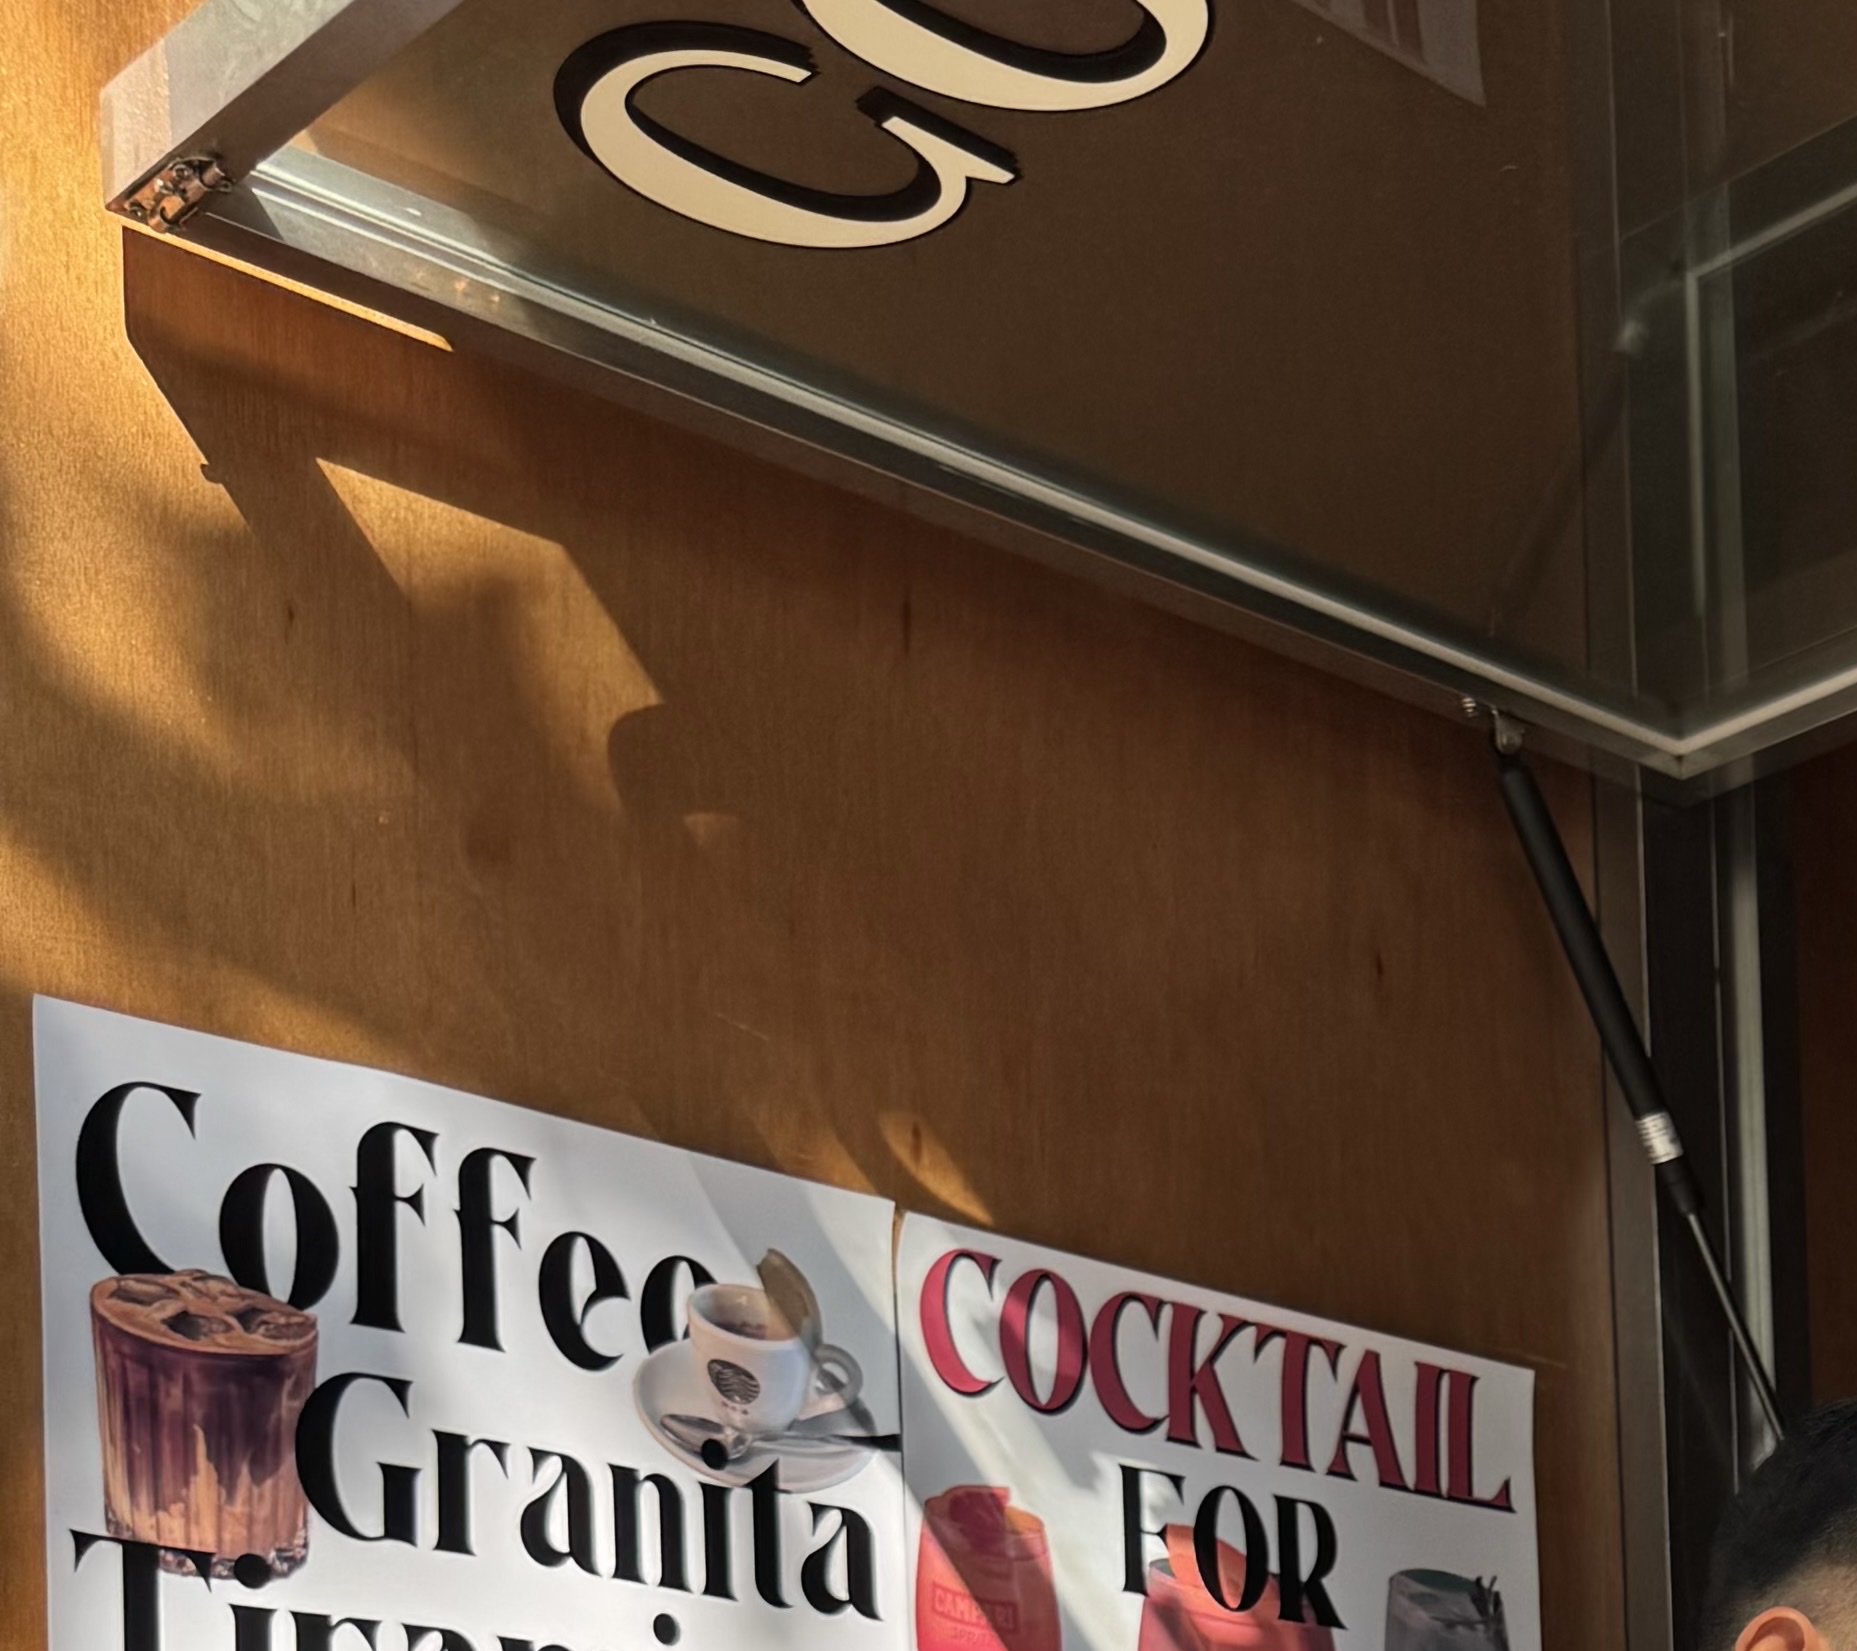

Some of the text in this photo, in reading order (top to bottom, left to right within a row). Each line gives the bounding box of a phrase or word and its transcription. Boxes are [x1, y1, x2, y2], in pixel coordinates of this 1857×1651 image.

[295, 1371, 883, 1621] Granita
[919, 1248, 1517, 1514] COCKTAIL
[1118, 1462, 1349, 1631] FOR
